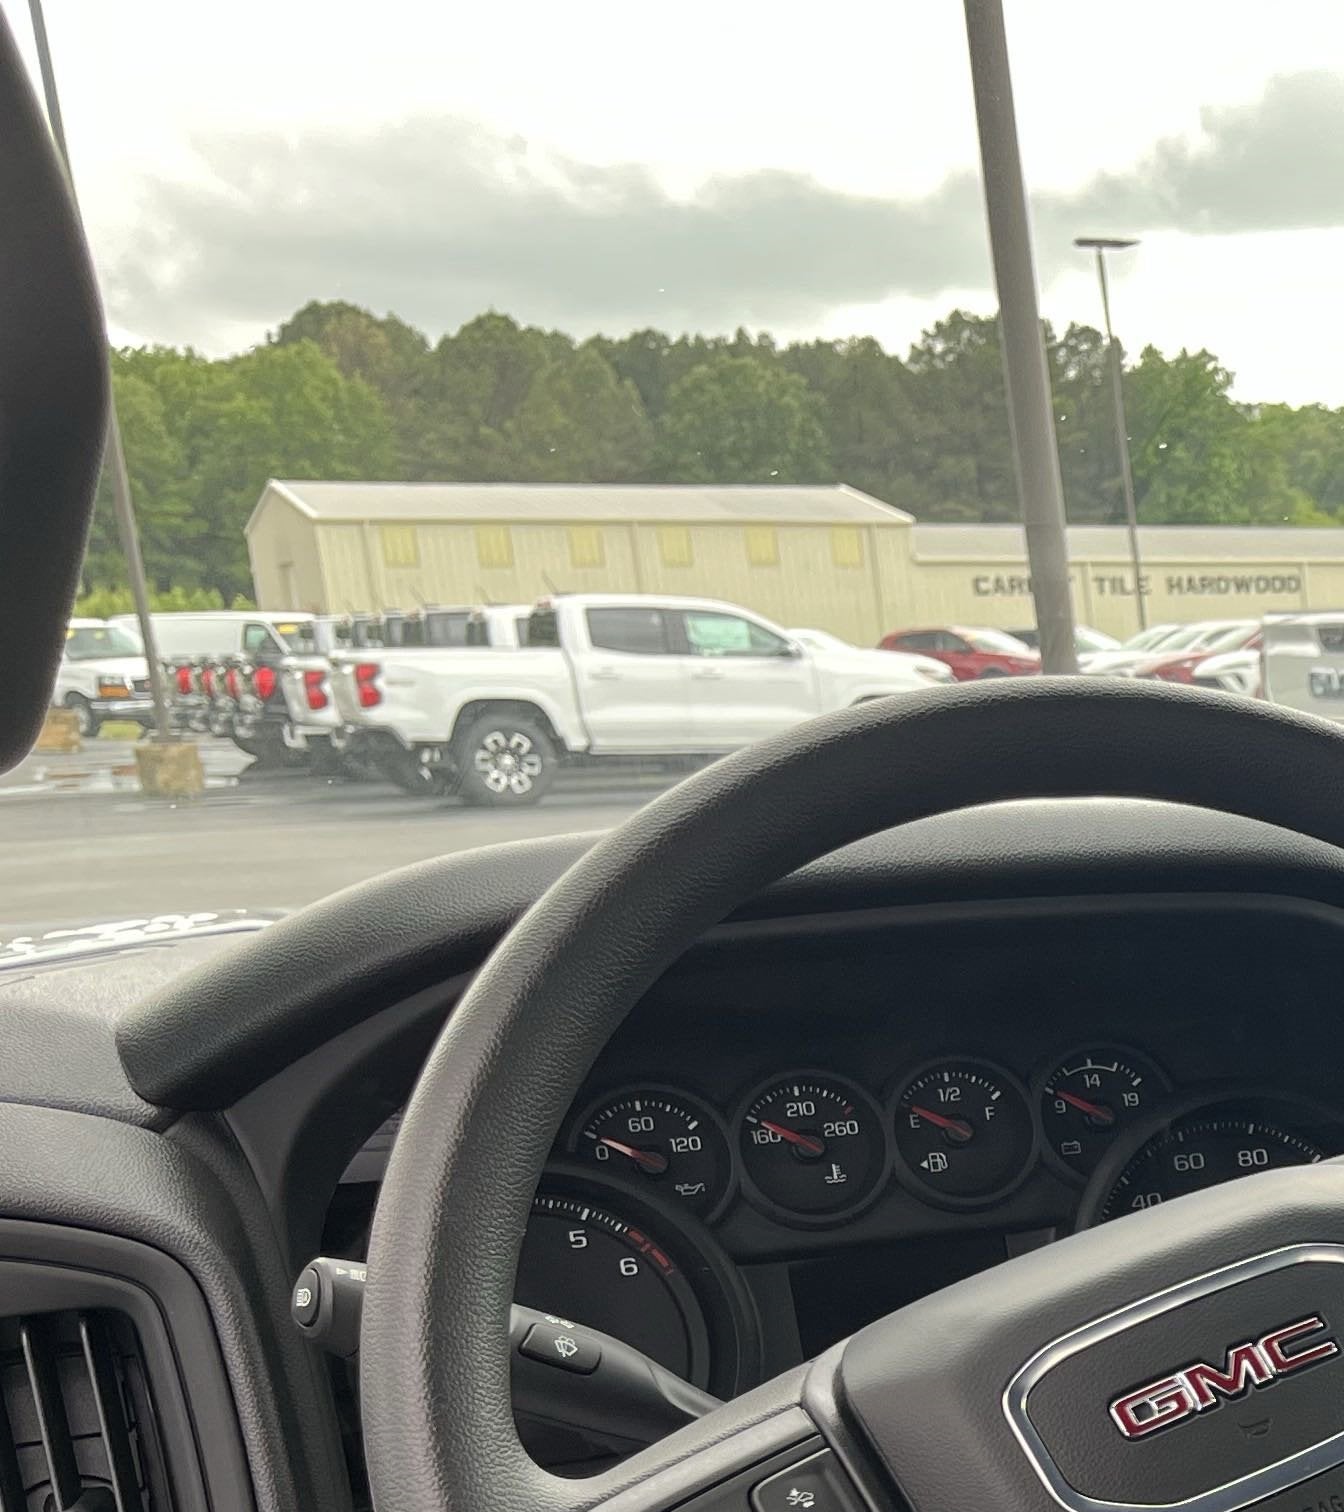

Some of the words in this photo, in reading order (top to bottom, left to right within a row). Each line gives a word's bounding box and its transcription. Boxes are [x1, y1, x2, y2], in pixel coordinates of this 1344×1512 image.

[1167, 577, 1299, 595] HARDWOOD
[1084, 1073, 1100, 1088] 14
[938, 1086, 961, 1103] 1/2
[1122, 1093, 1139, 1108] 19
[785, 1101, 816, 1117] 210
[985, 1107, 995, 1121] F
[1054, 1100, 1067, 1114] 9
[628, 1116, 654, 1133] 60
[823, 1121, 859, 1137] 260
[909, 1114, 921, 1129] E
[669, 1135, 702, 1152] 120
[750, 1130, 782, 1145] 160
[595, 1146, 609, 1161] 0
[1173, 1152, 1205, 1171] 60
[1237, 1148, 1268, 1167] 80
[569, 1229, 588, 1249] 5
[620, 1257, 638, 1276] 6
[1109, 1316, 1338, 1437] GMC
